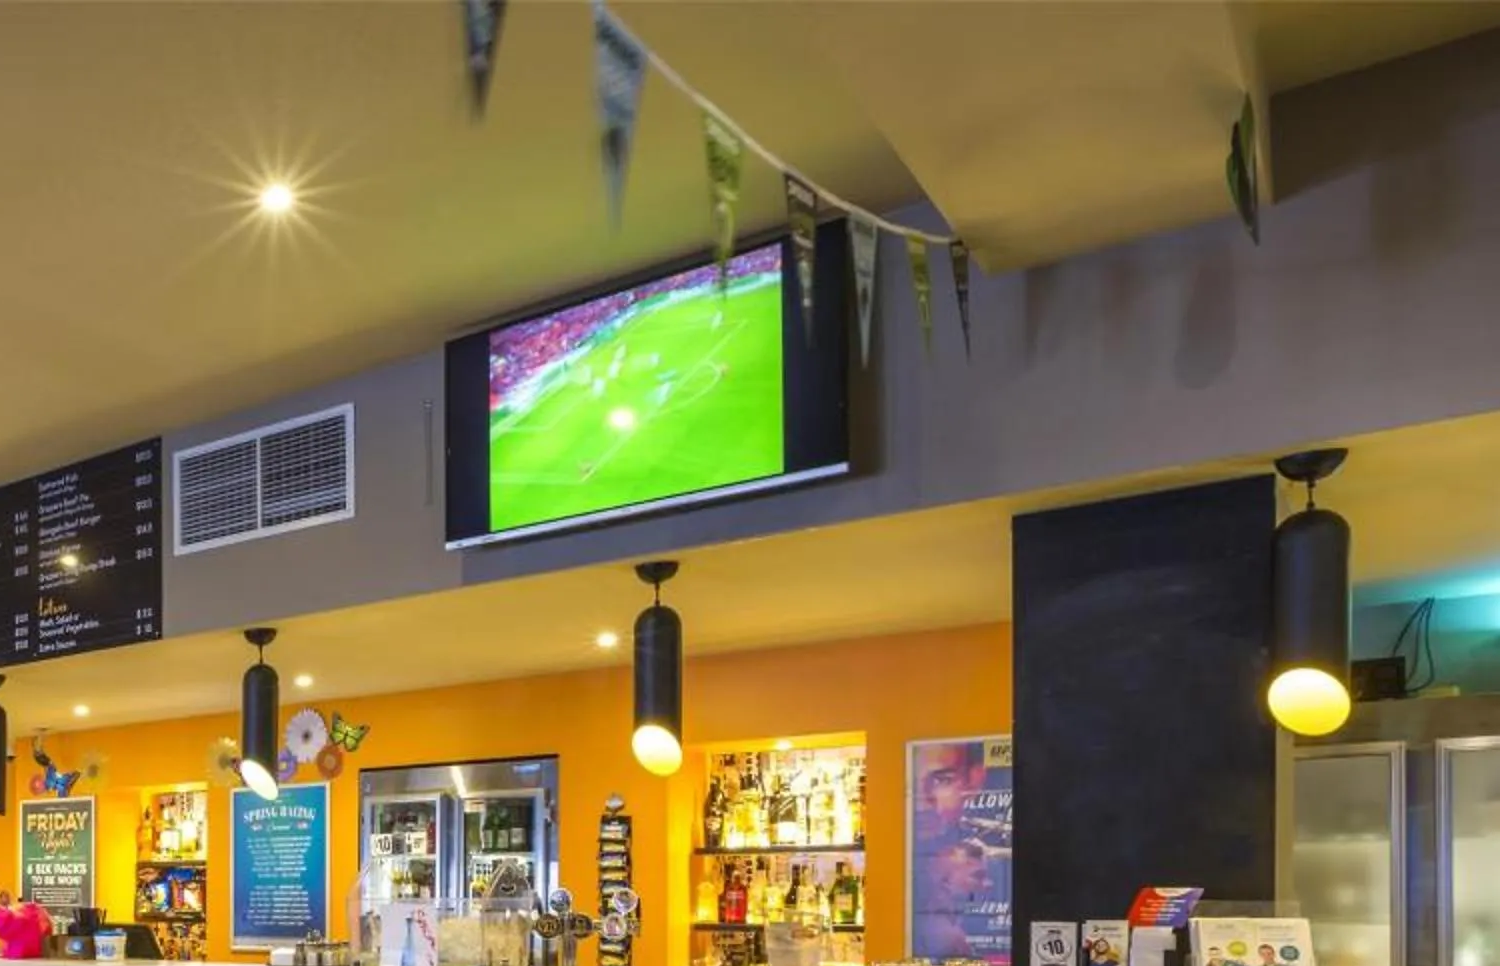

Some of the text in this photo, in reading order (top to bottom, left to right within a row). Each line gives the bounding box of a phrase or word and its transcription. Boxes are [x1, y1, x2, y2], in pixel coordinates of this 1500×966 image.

[27, 811, 89, 832] FRIDAY
[243, 805, 317, 823] SPRING RACING
[53, 863, 87, 875] PACKS
[31, 875, 43, 885] TO
